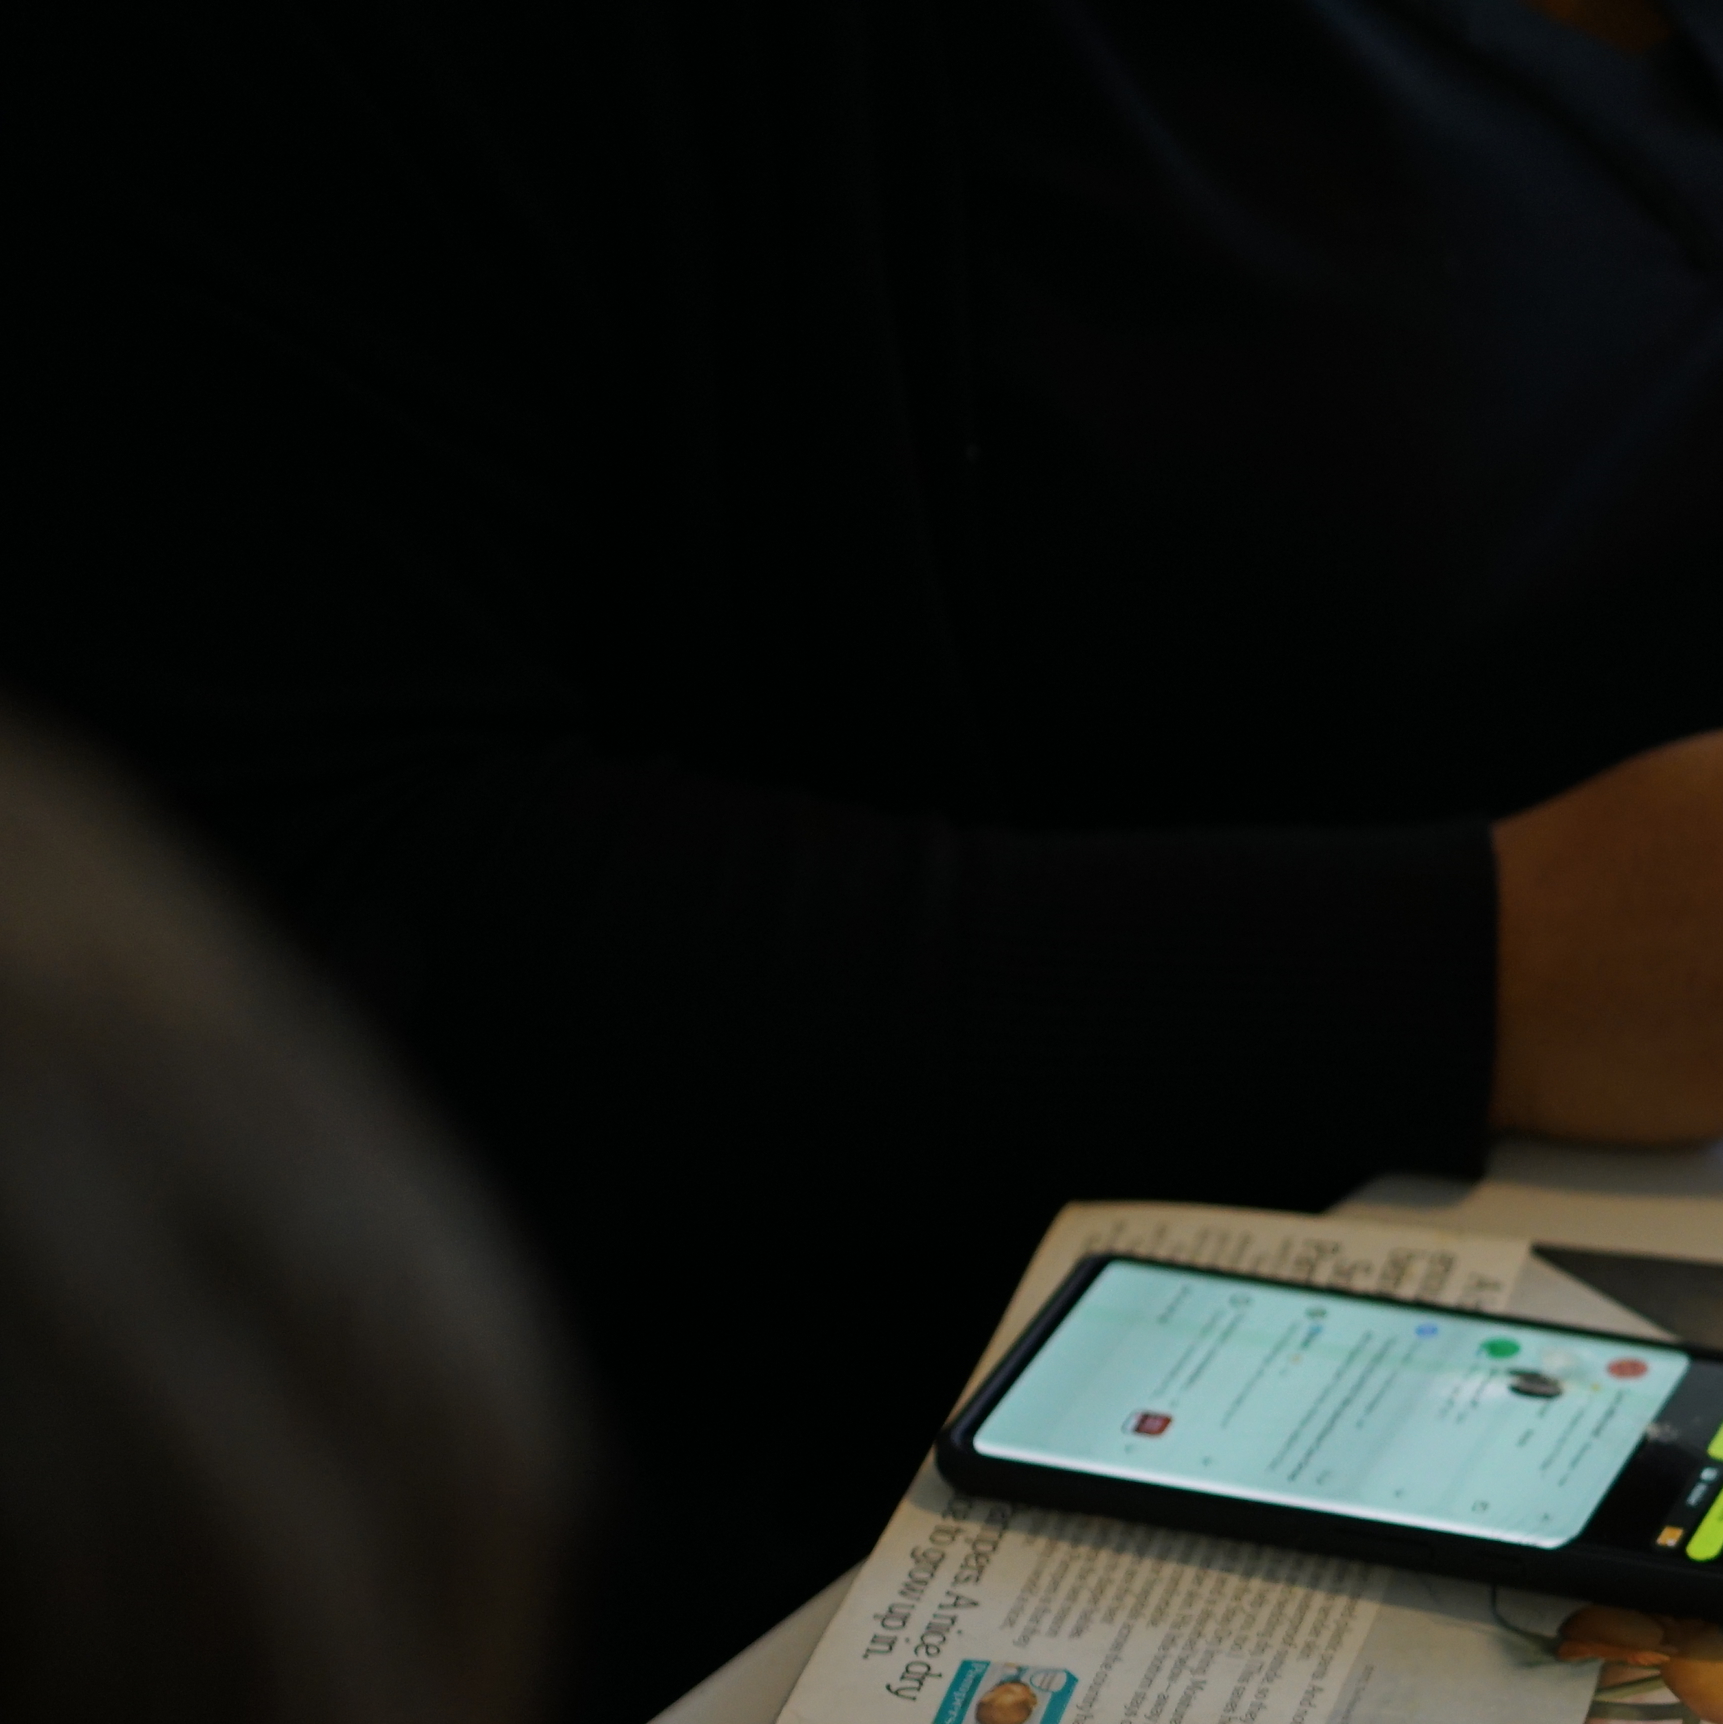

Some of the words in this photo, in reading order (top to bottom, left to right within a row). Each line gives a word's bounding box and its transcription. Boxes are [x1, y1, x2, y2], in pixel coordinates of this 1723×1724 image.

[950, 1500, 1023, 1589] ampers.
[887, 1542, 945, 1601] grow
[869, 1598, 916, 1632] up
[937, 1589, 981, 1614] A
[861, 1630, 910, 1666] in.
[911, 1609, 968, 1661] nice
[884, 1655, 947, 1704] dry
